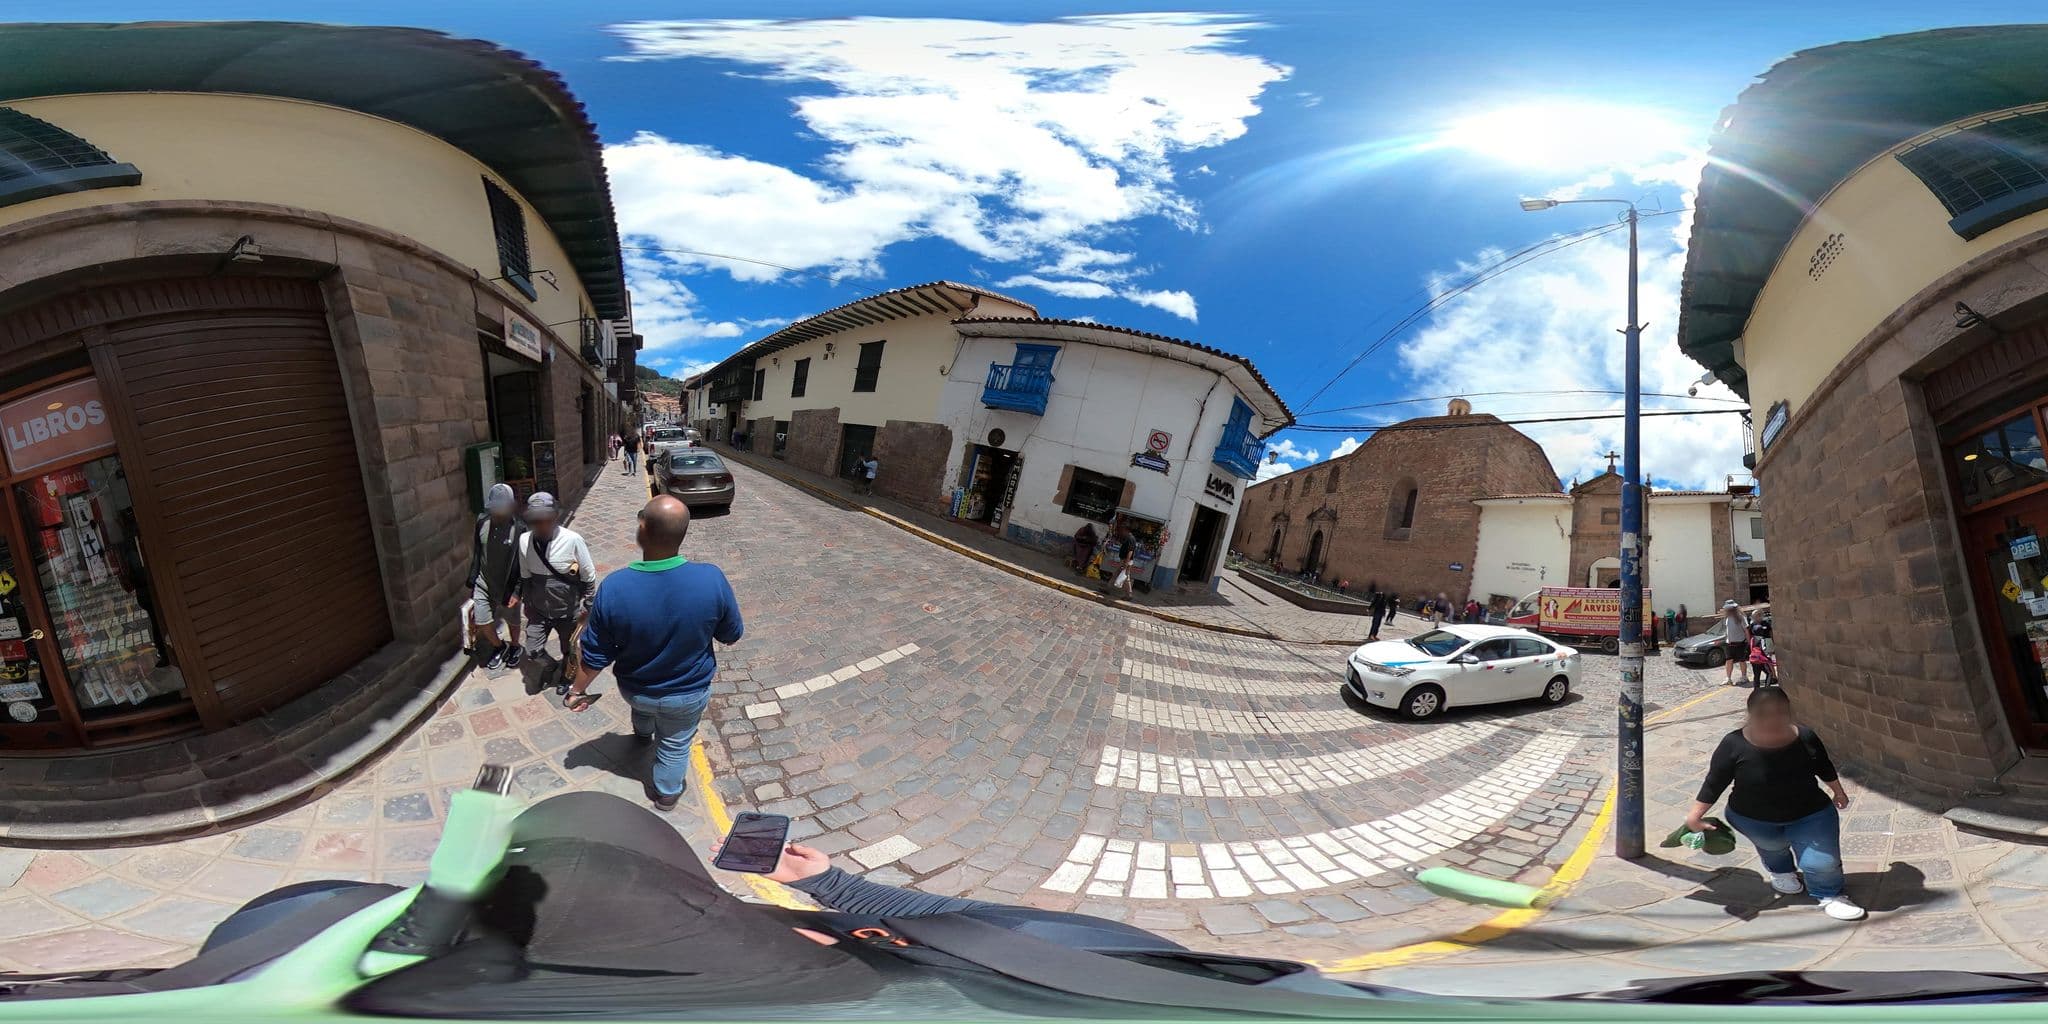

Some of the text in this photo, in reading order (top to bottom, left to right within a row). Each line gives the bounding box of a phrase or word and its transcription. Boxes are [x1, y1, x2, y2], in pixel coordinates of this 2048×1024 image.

[1809, 233, 1844, 276] ANDINA
[1811, 233, 1836, 263] CASA
[8, 400, 105, 450] LIBROS
[2011, 540, 2040, 555] OPEN
[1583, 604, 1620, 612] ARVISU
